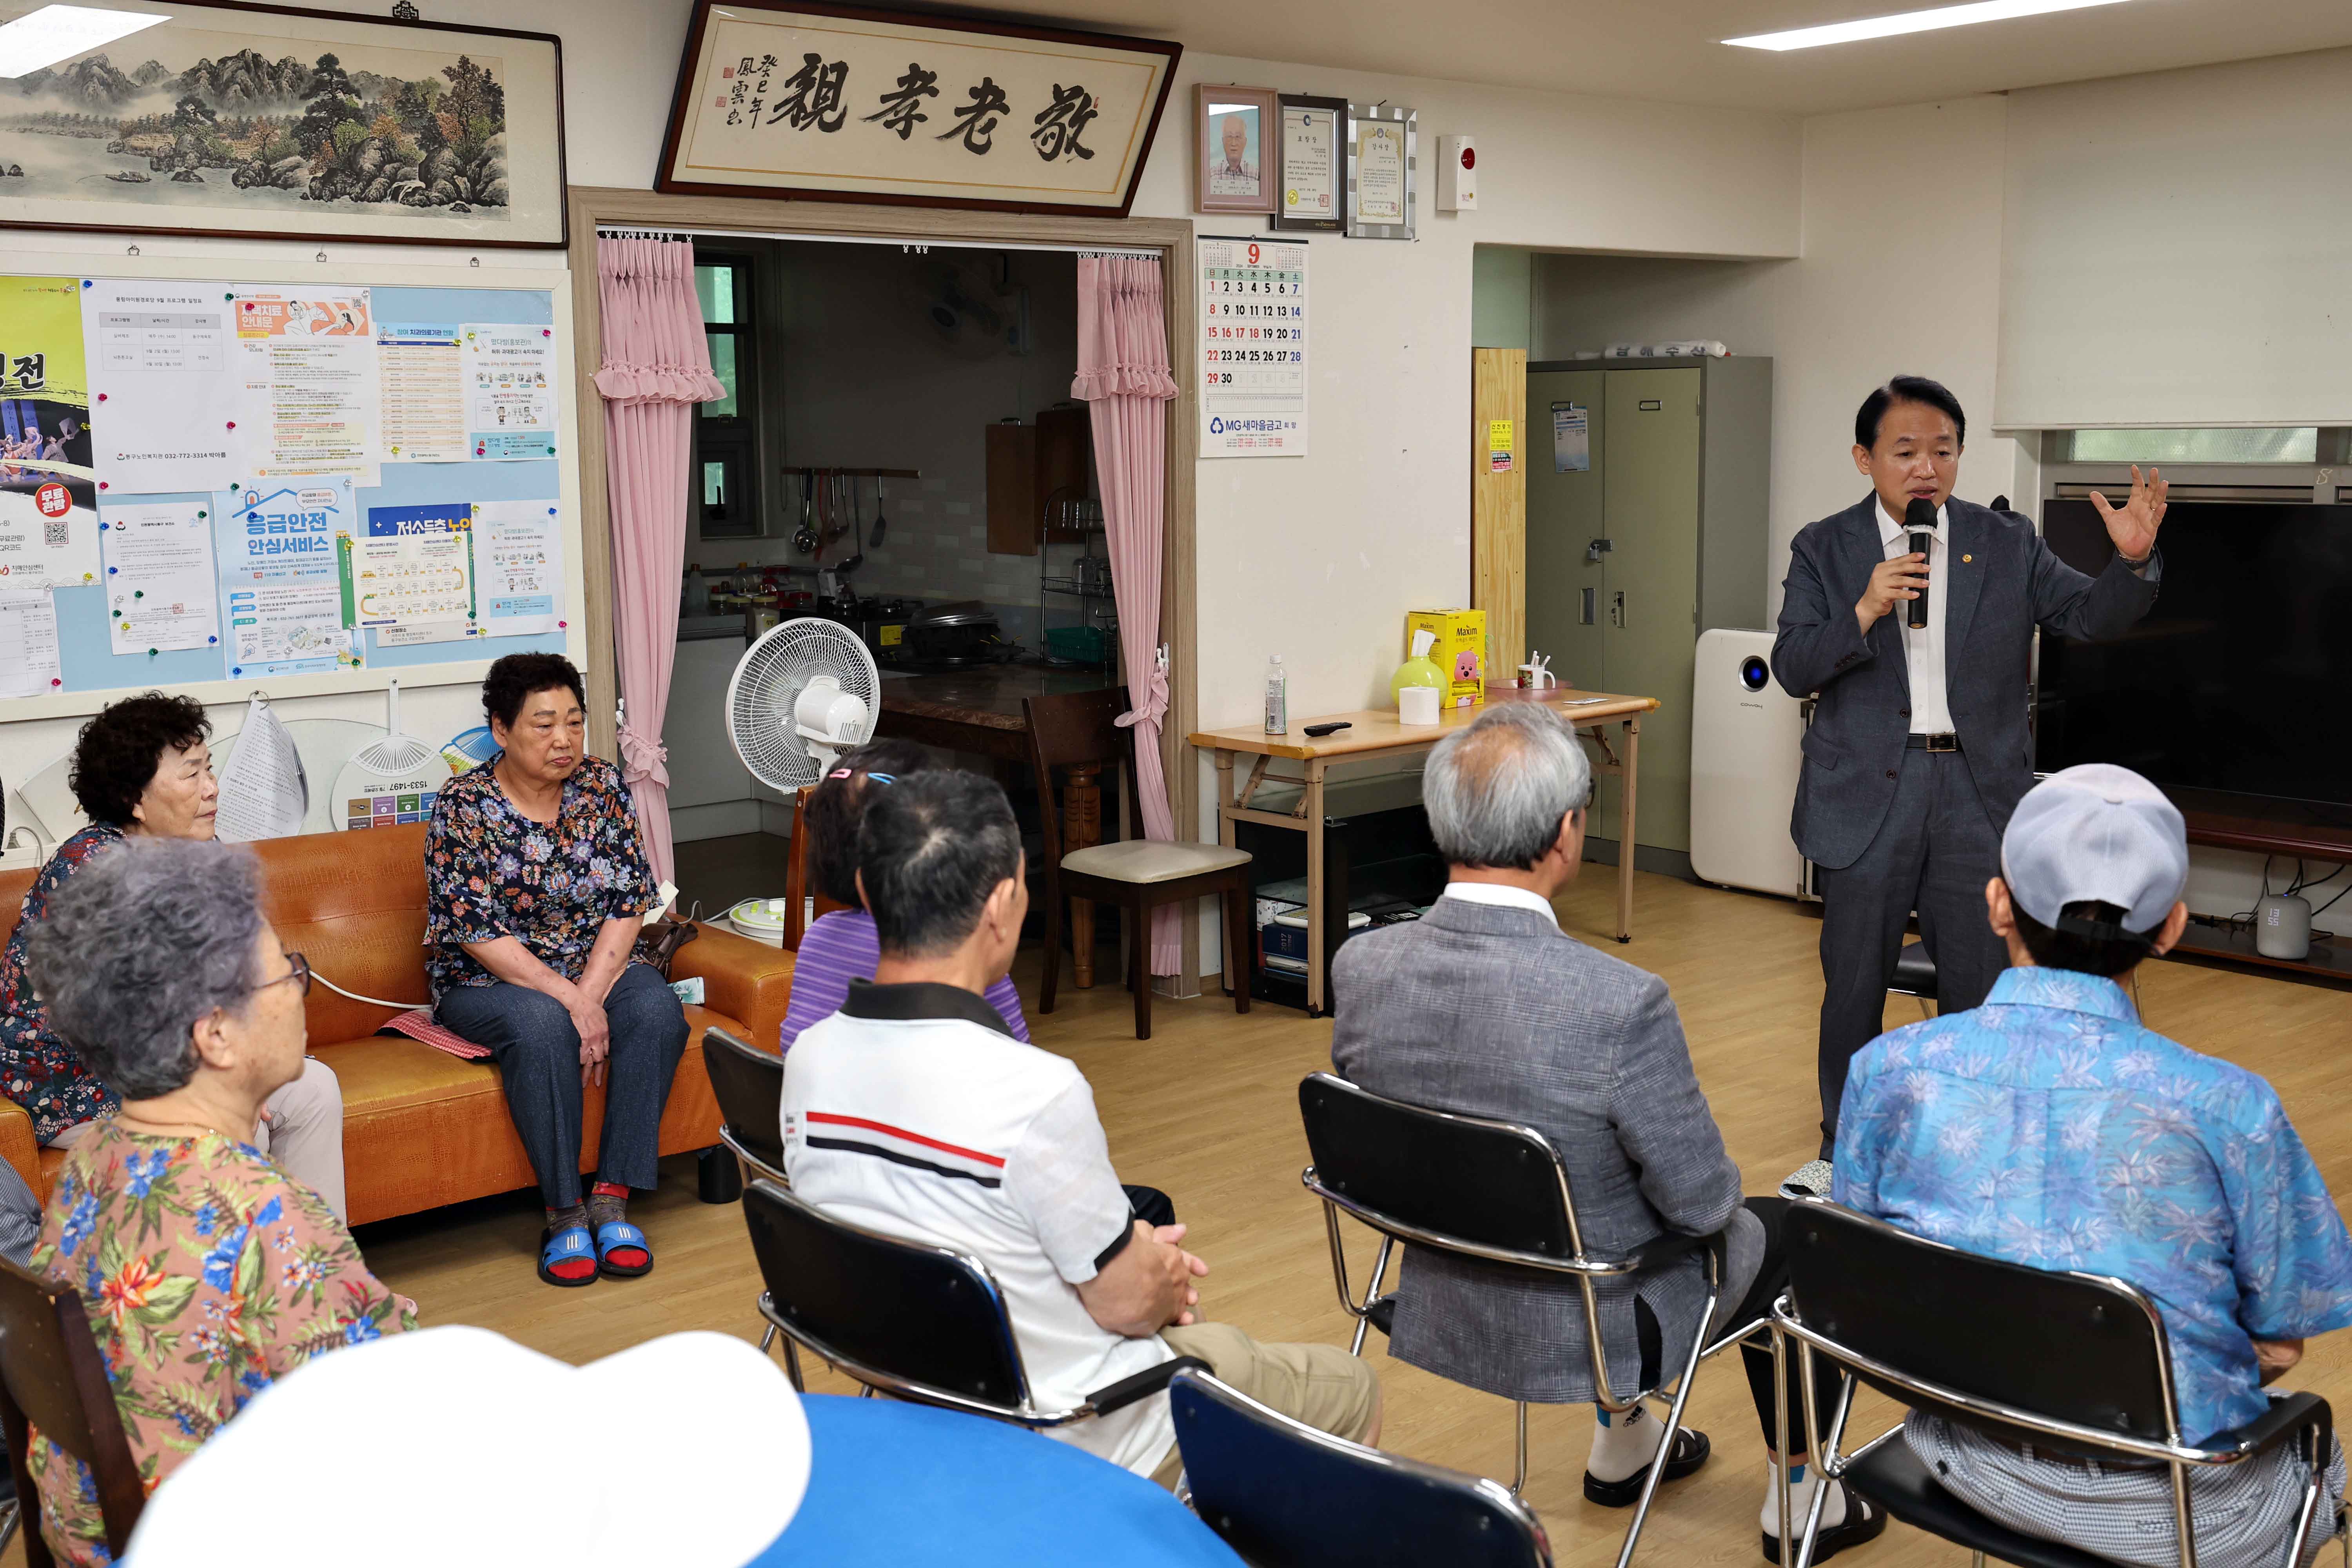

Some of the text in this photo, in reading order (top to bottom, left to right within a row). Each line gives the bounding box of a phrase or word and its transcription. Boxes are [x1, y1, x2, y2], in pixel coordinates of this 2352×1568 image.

[1248, 243, 1260, 264] 9
[1210, 281, 1298, 294] 1 2 3 4 5 6 7
[1210, 304, 1300, 317] 8 9 10 11 12 13 14
[242, 317, 273, 328] 안내문
[1208, 327, 1300, 339] 15 16 17 18 19 20 21
[1207, 350, 1301, 362] 22 23 24 25 26 27 28
[0, 352, 46, 389] 전
[1207, 373, 1232, 384] 29 30
[41, 487, 64, 502] 무료
[42, 499, 65, 514] 관람
[246, 512, 327, 535] 응급안전
[248, 536, 328, 555] 안심서비스
[1456, 626, 1477, 636] Maxim
[390, 781, 428, 791] 1533-1497
[1623, 1408, 1646, 1427] adidas
